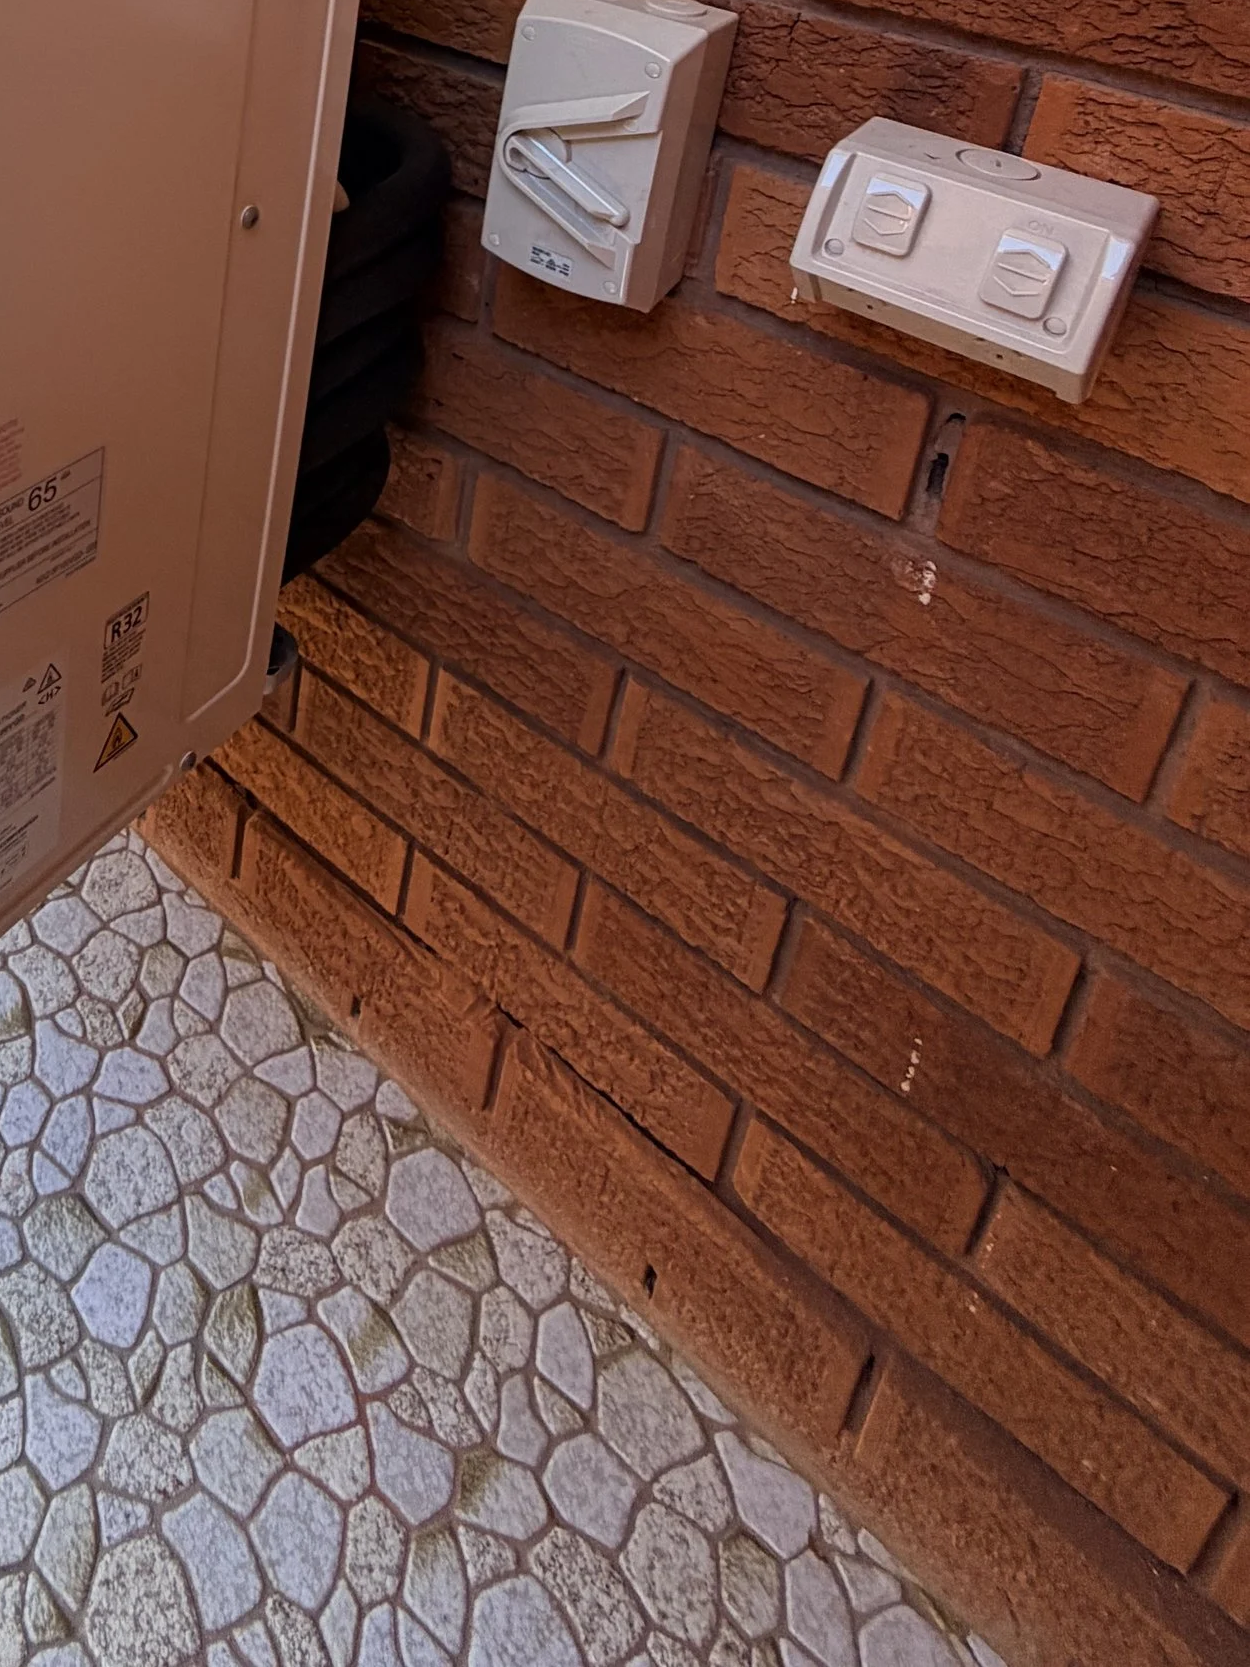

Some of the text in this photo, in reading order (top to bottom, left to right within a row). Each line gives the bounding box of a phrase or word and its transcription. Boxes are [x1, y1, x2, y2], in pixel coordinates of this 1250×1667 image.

[1029, 220, 1054, 235] ON
[28, 477, 58, 512] 65
[111, 605, 143, 643] R32
